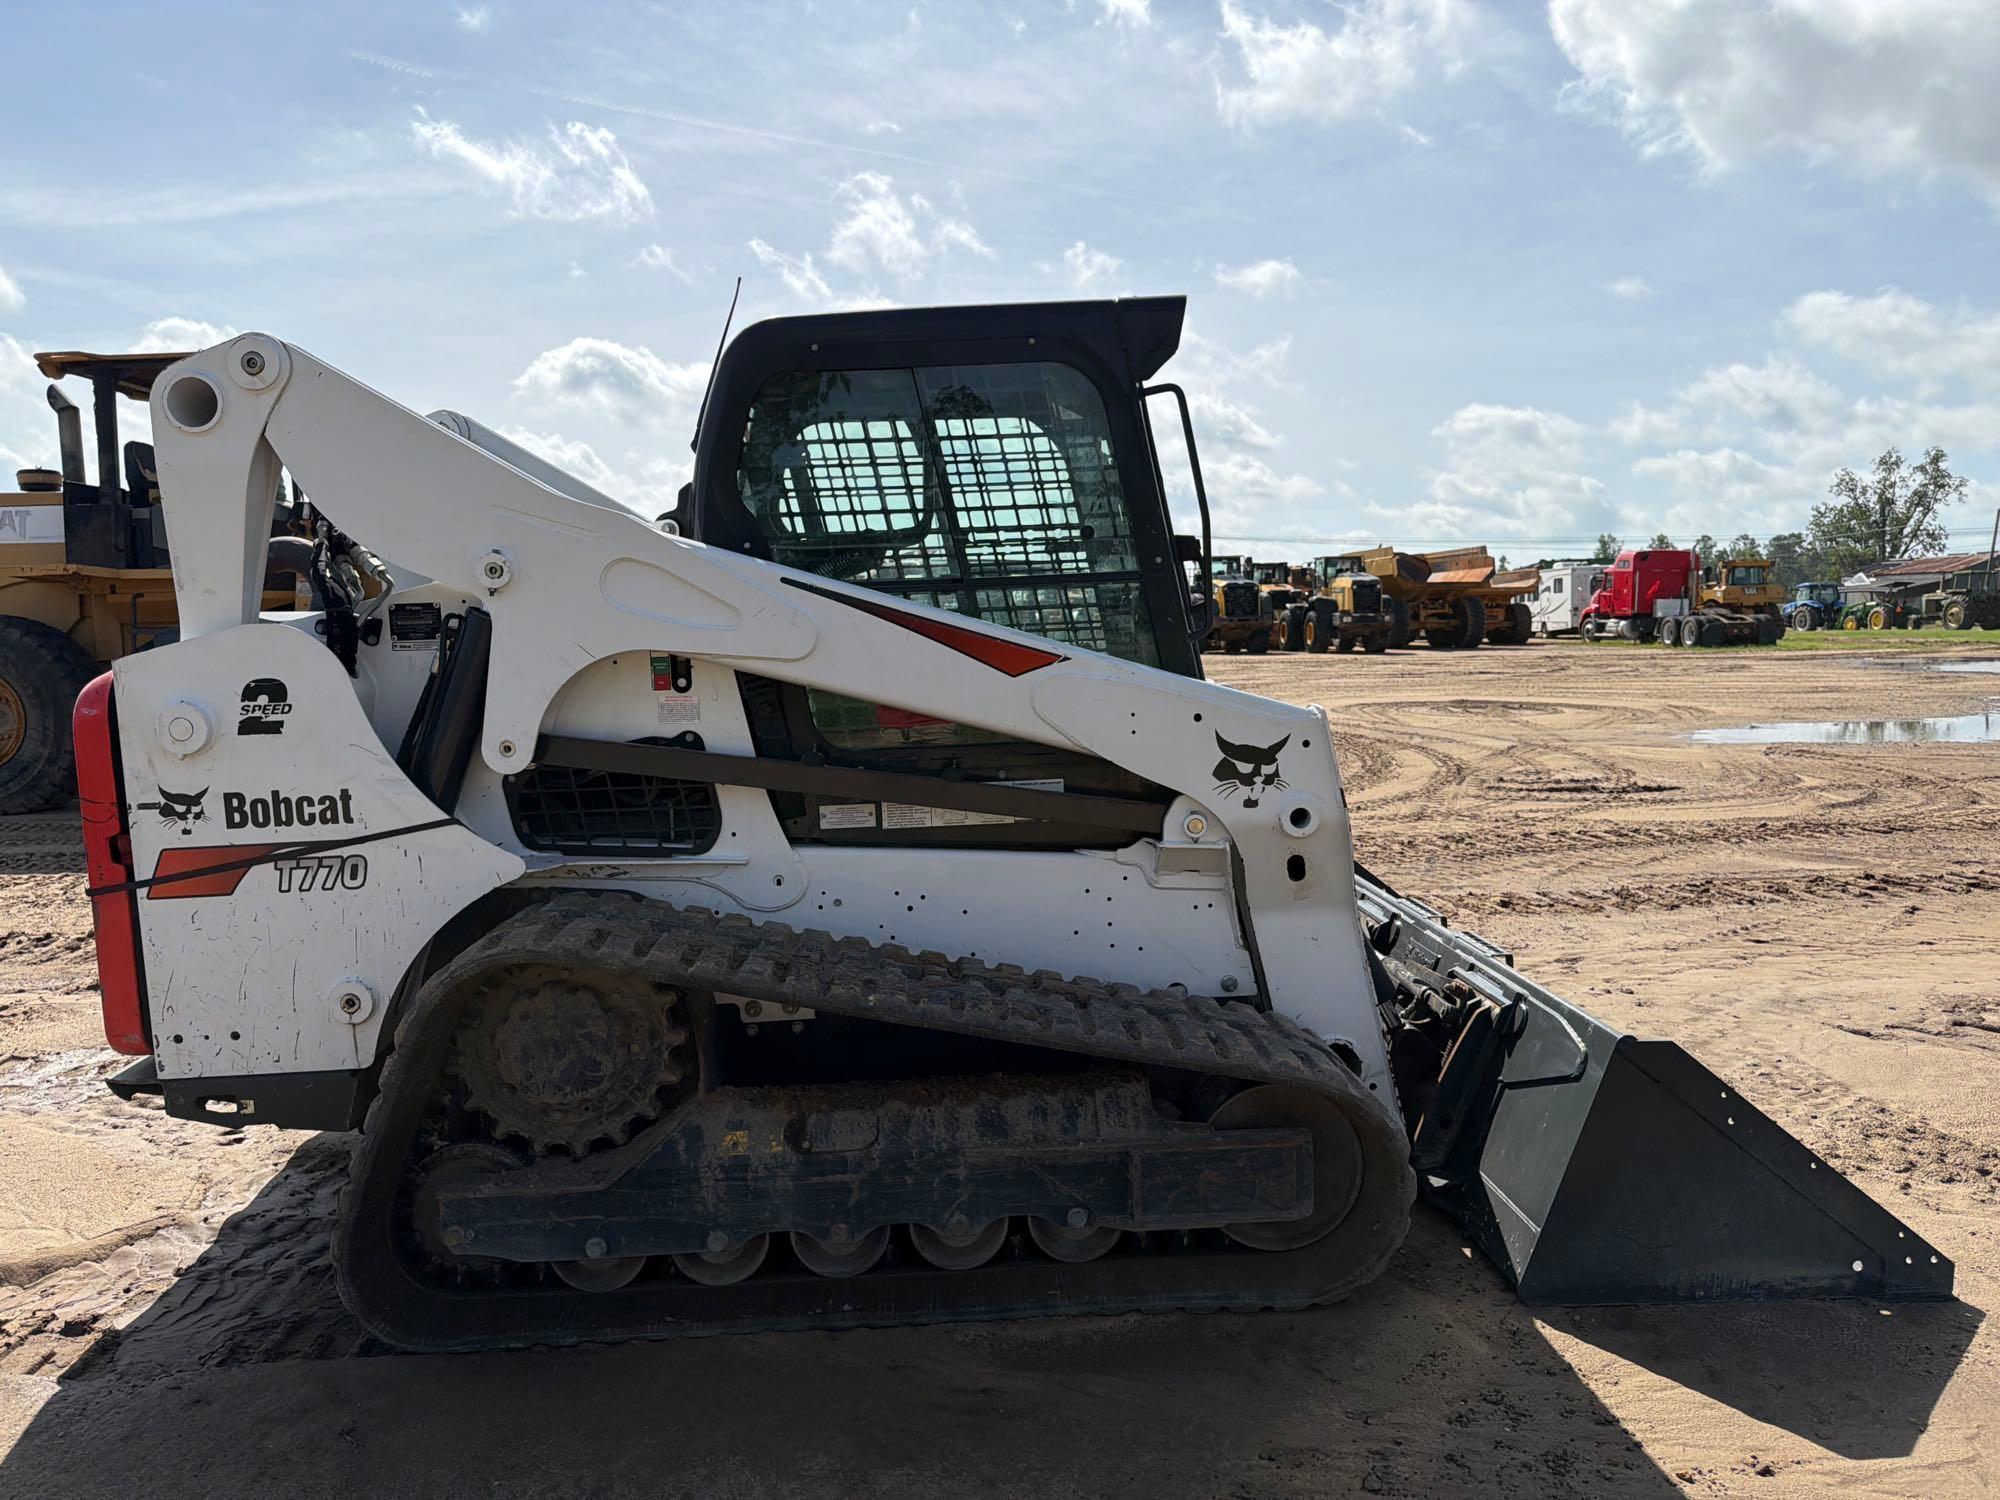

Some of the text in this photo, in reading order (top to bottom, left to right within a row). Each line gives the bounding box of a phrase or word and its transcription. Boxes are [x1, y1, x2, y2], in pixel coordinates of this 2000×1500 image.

[239, 703, 292, 716] SPEED
[223, 788, 354, 830] Bobcat
[274, 854, 368, 893] T770
